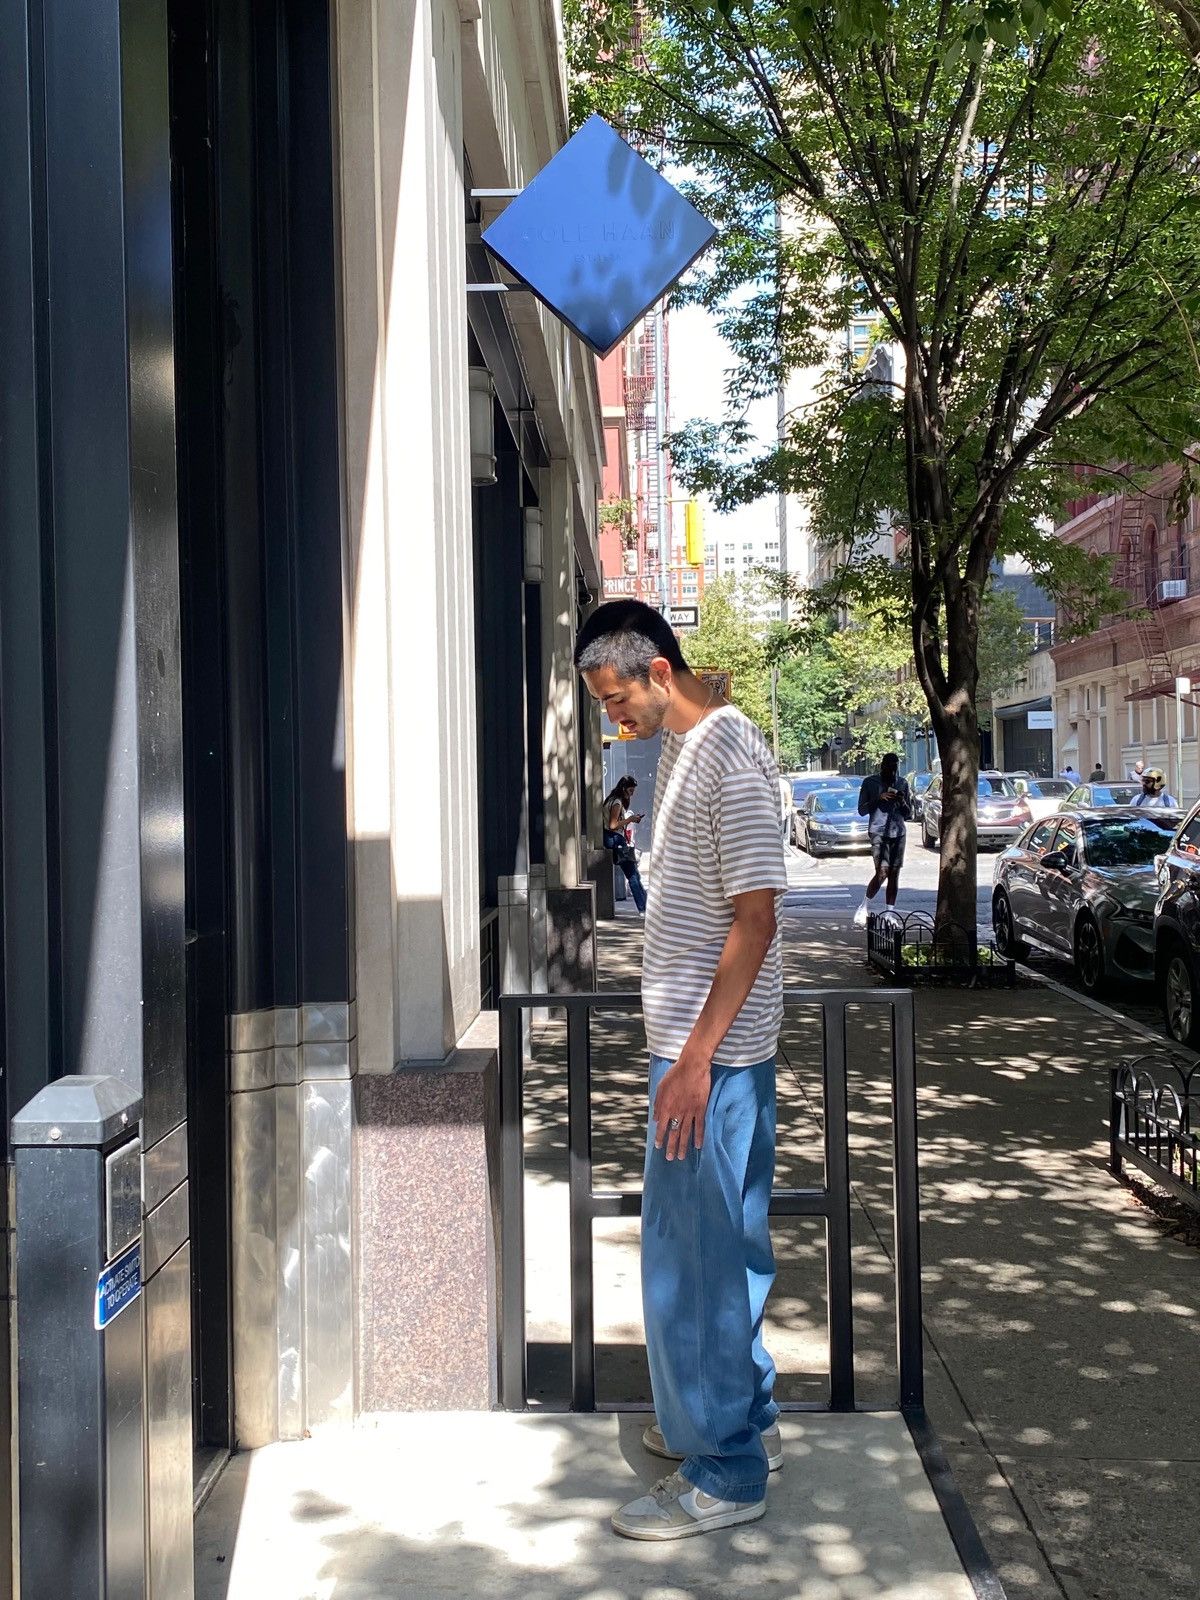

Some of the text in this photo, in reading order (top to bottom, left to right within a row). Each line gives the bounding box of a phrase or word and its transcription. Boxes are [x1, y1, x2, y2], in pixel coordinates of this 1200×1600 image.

[602, 220, 675, 241] HAAN
[603, 577, 653, 593] PRINCE ST
[670, 613, 690, 622] WAY
[107, 1272, 138, 1310] TO OPERATE
